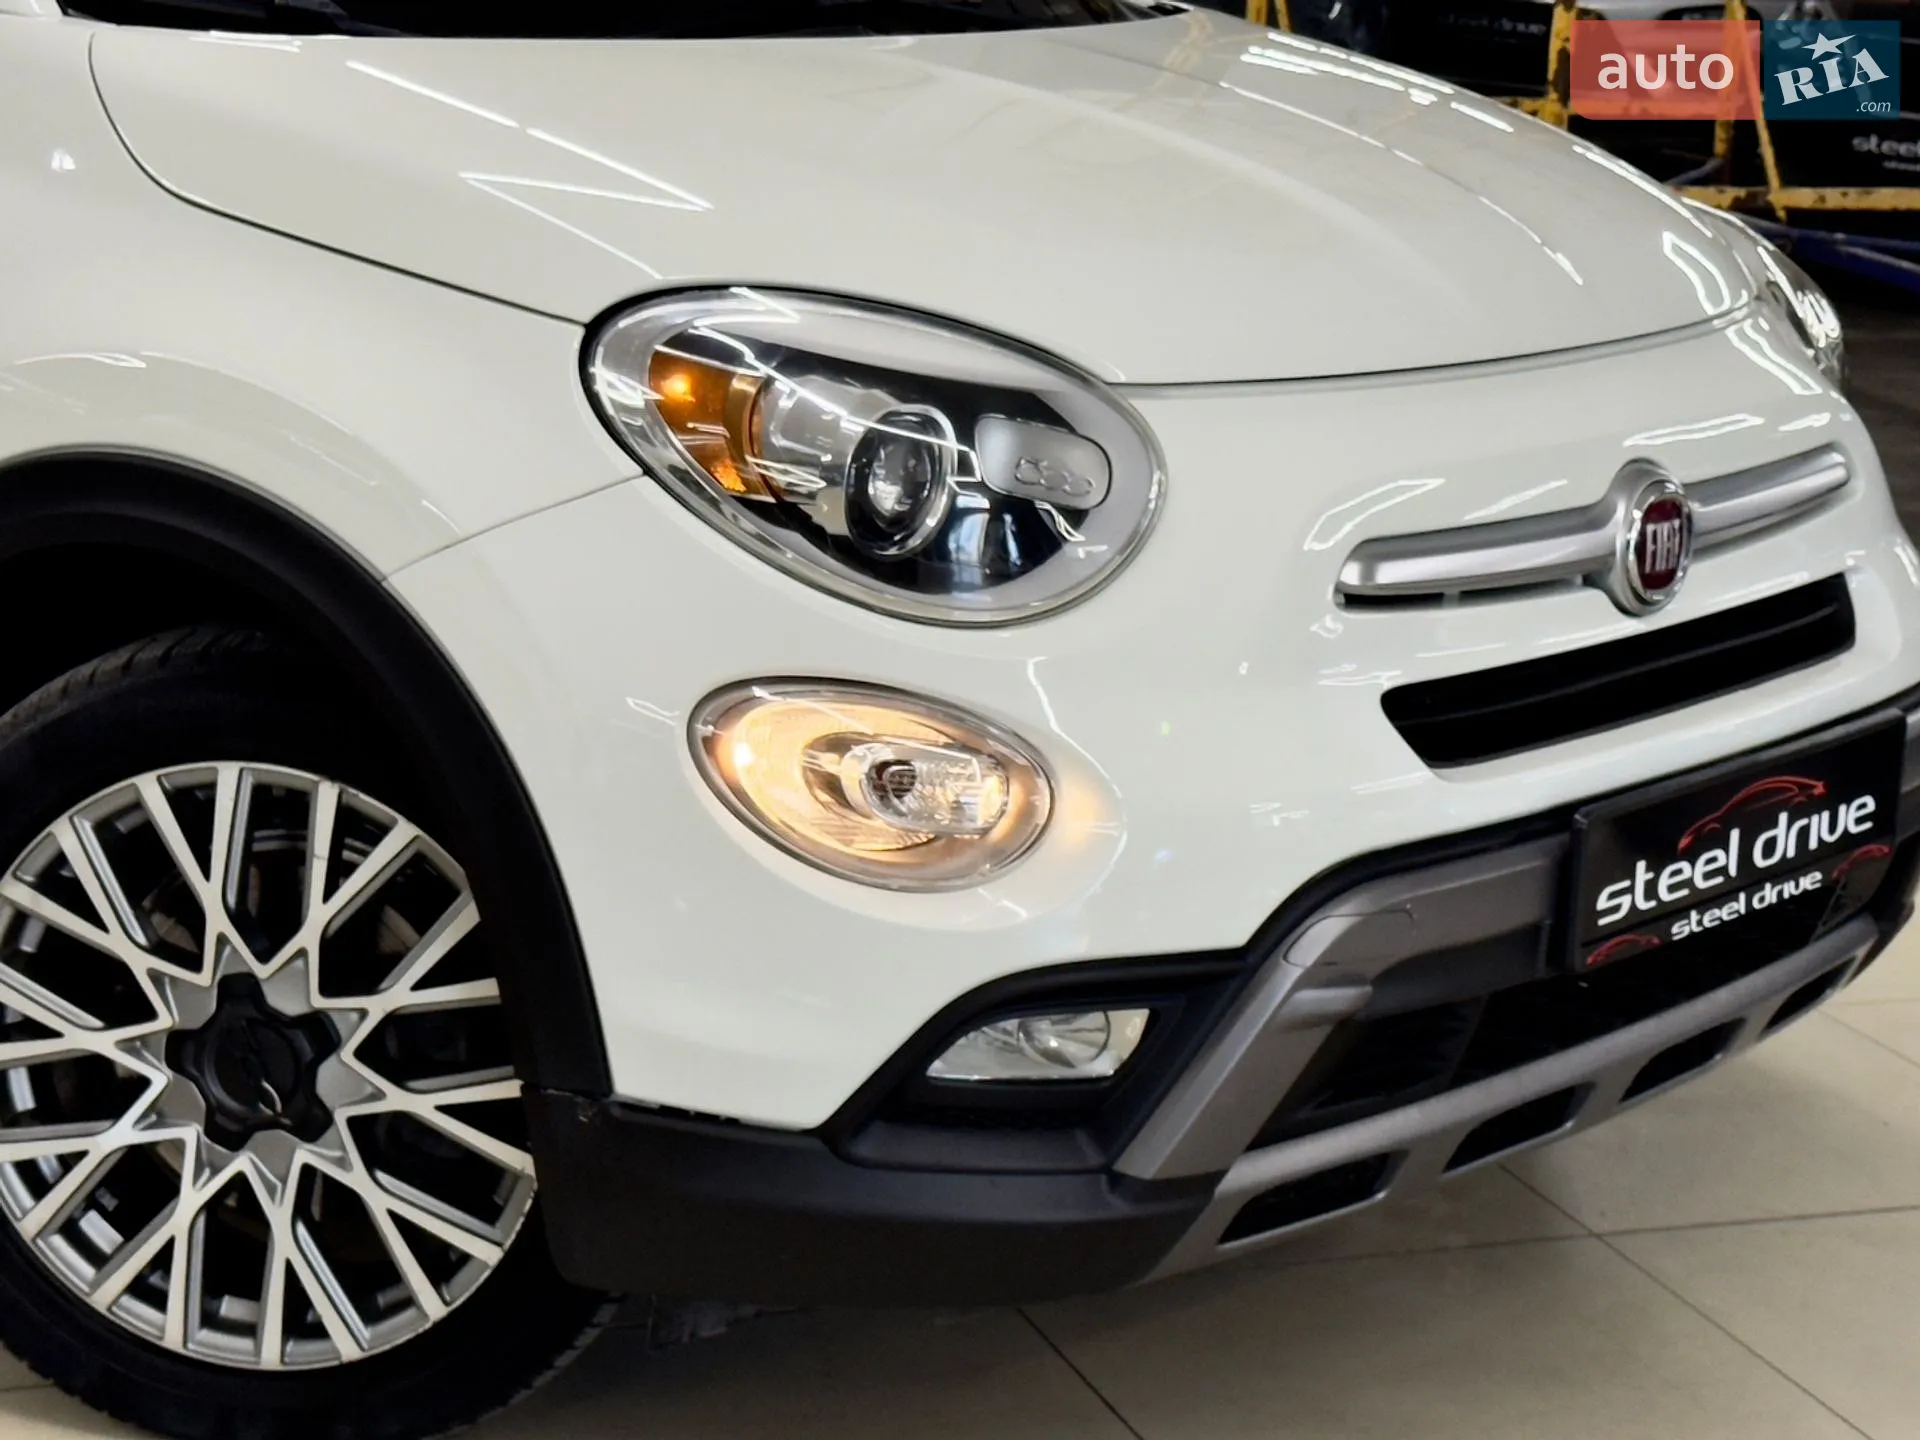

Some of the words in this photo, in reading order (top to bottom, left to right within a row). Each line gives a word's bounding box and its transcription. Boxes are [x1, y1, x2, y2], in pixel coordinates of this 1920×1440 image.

[1644, 518, 1681, 574] FIAT
[1596, 828, 1741, 927] steel
[1752, 794, 1876, 869] drive
[1671, 891, 1746, 941] steel
[1752, 870, 1823, 910] drive
